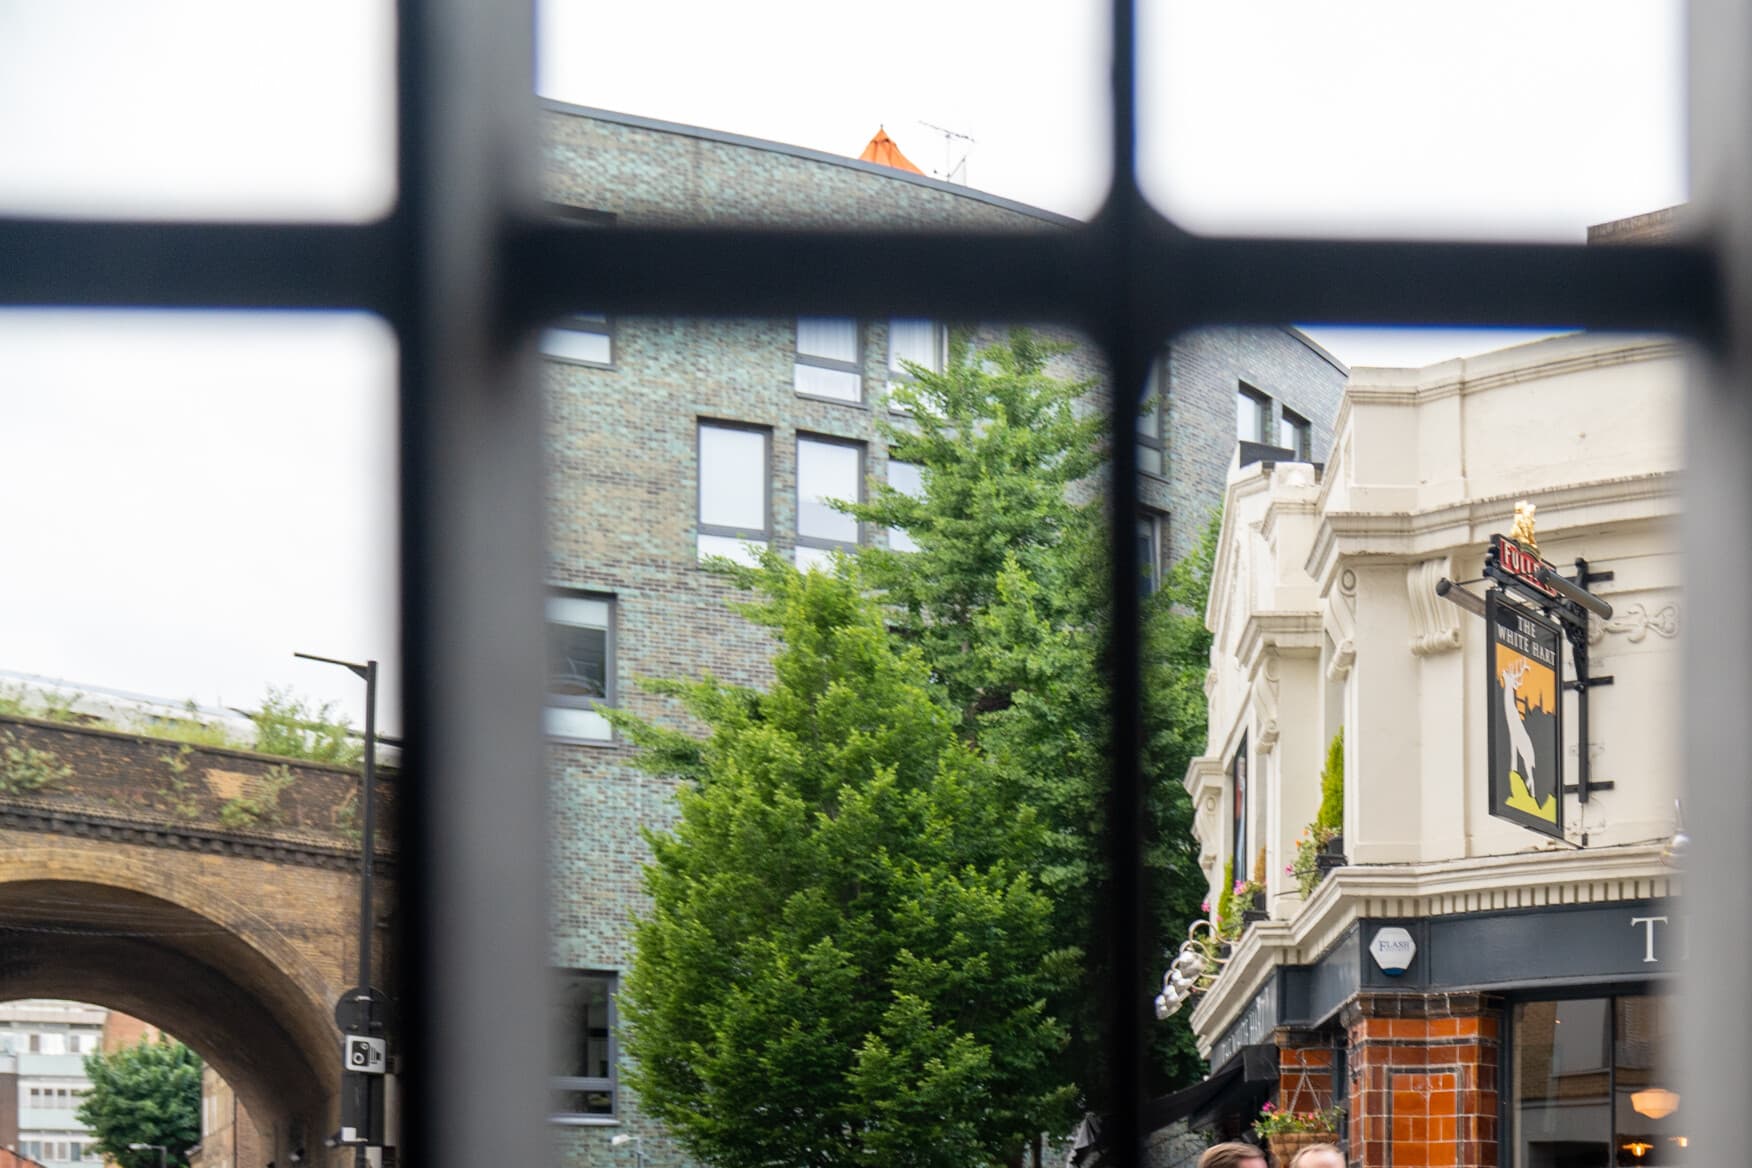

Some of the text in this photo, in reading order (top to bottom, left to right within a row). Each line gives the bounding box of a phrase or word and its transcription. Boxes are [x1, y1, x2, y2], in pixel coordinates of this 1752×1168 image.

[1517, 615, 1536, 639] THE
[1496, 623, 1556, 667] WHITE HART
